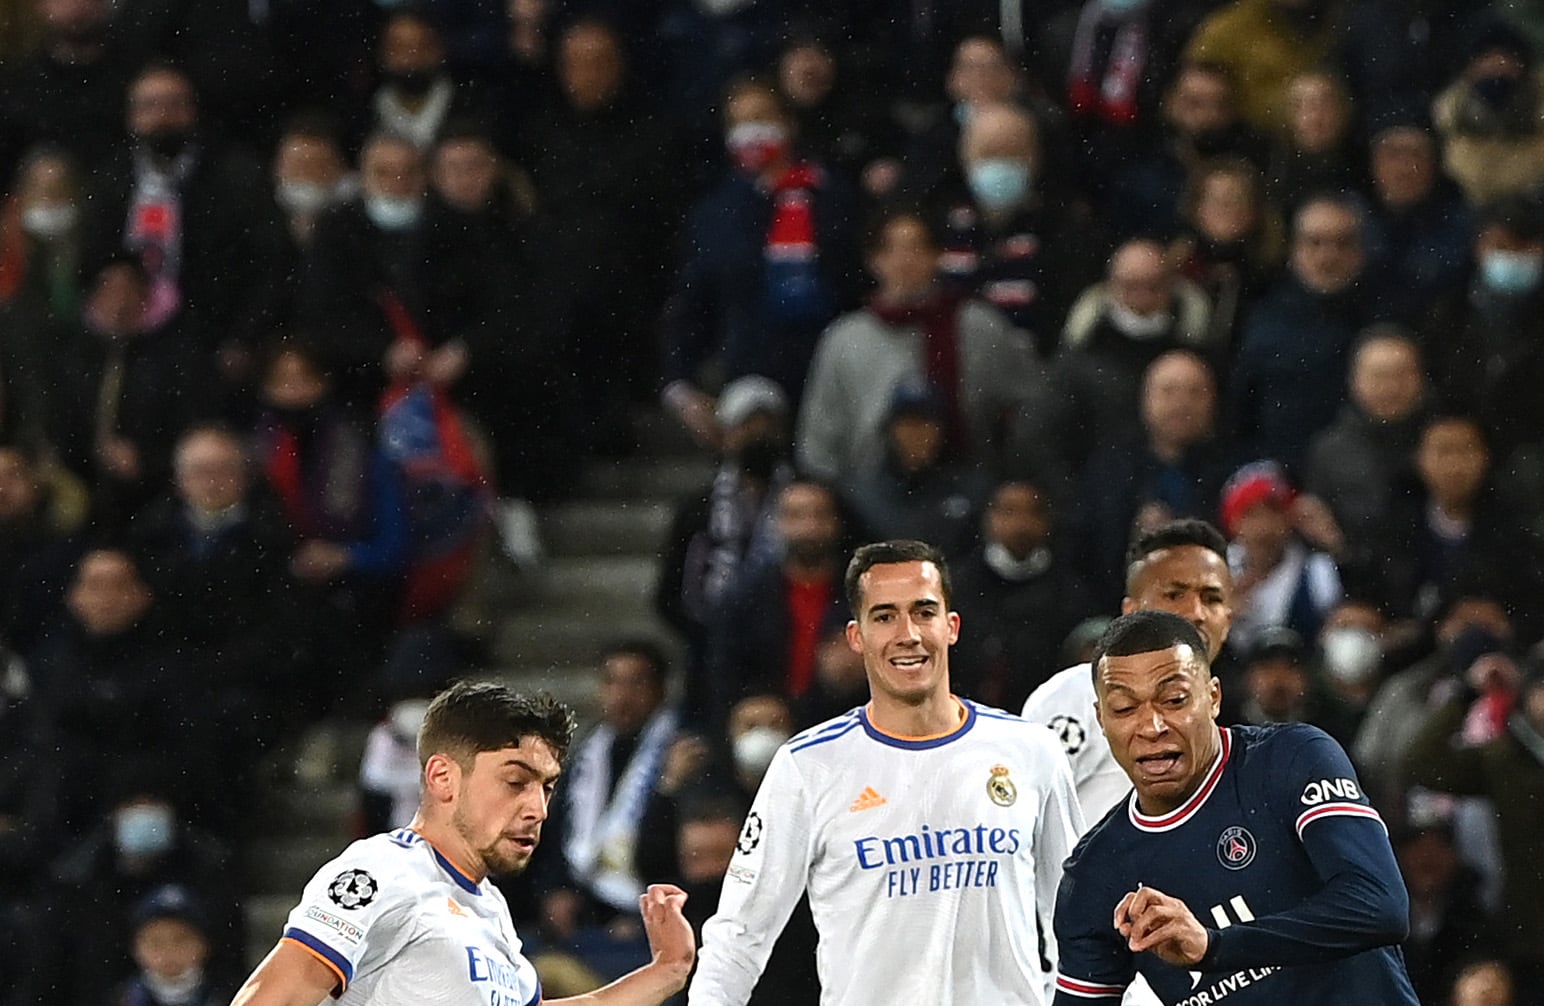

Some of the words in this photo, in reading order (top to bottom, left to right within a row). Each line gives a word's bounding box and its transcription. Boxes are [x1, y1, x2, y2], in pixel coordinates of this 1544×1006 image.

[1300, 778, 1360, 806] QNB
[853, 823, 1020, 870] Emirates
[888, 867, 920, 898] FLY
[929, 860, 998, 892] BETTER
[1211, 970, 1251, 1001] LIVE
